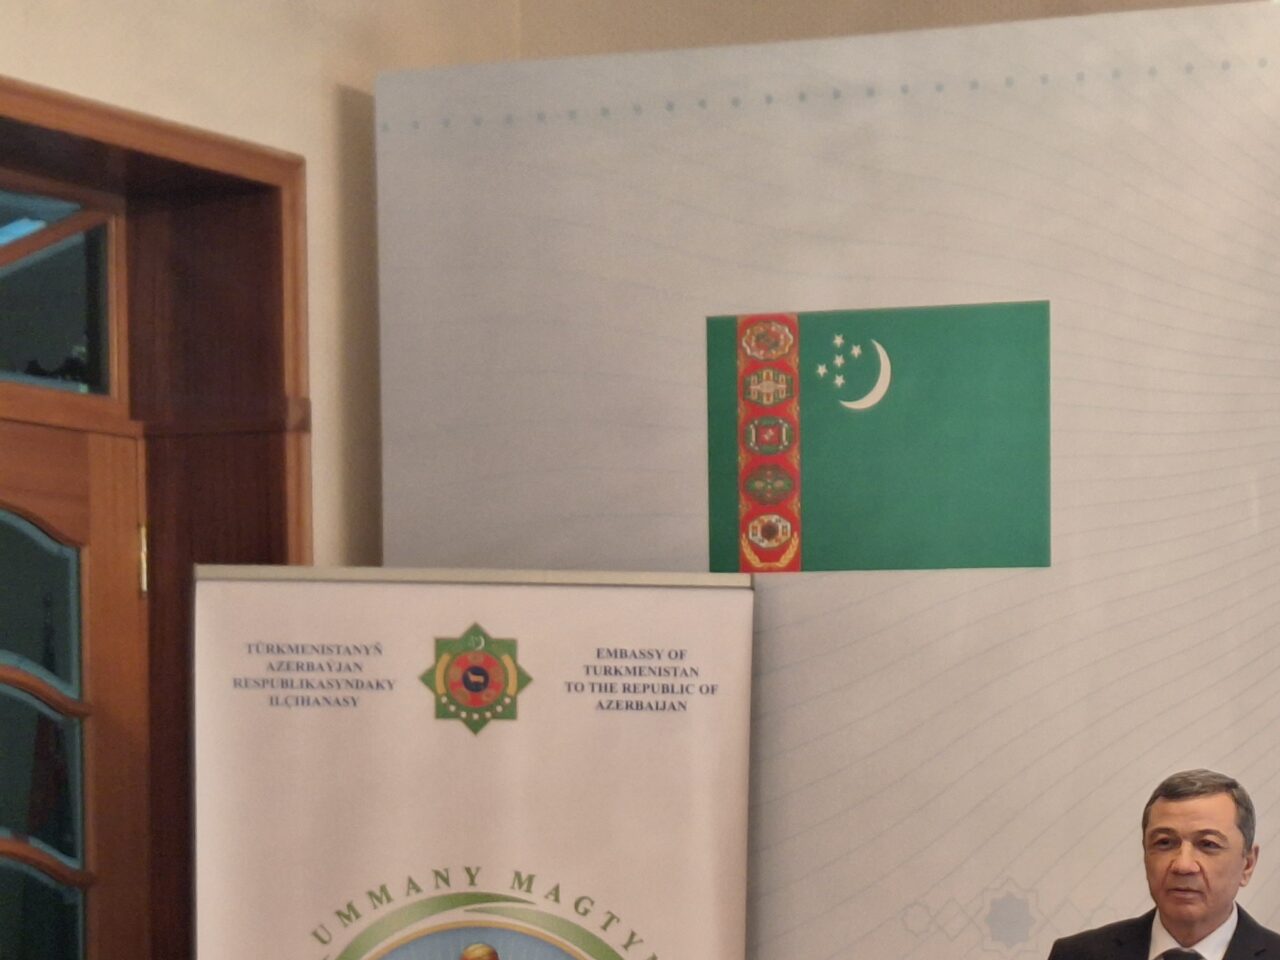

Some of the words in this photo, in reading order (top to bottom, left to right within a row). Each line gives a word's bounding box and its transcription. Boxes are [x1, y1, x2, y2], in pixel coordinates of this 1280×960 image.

[596, 647, 664, 660] EMBASSY
[668, 649, 688, 660] OF
[266, 659, 363, 672] AZERBAÝJAN
[584, 664, 699, 677] TURKMENISTAN
[232, 677, 395, 690] RESPUBLIKASYNDAKY
[565, 681, 585, 693] TO
[589, 682, 618, 694] THE
[622, 683, 694, 695] REPUBLIC
[699, 684, 719, 695] OF
[596, 699, 688, 711] AZERBAIJAN
[311, 866, 482, 946] UMMANY
